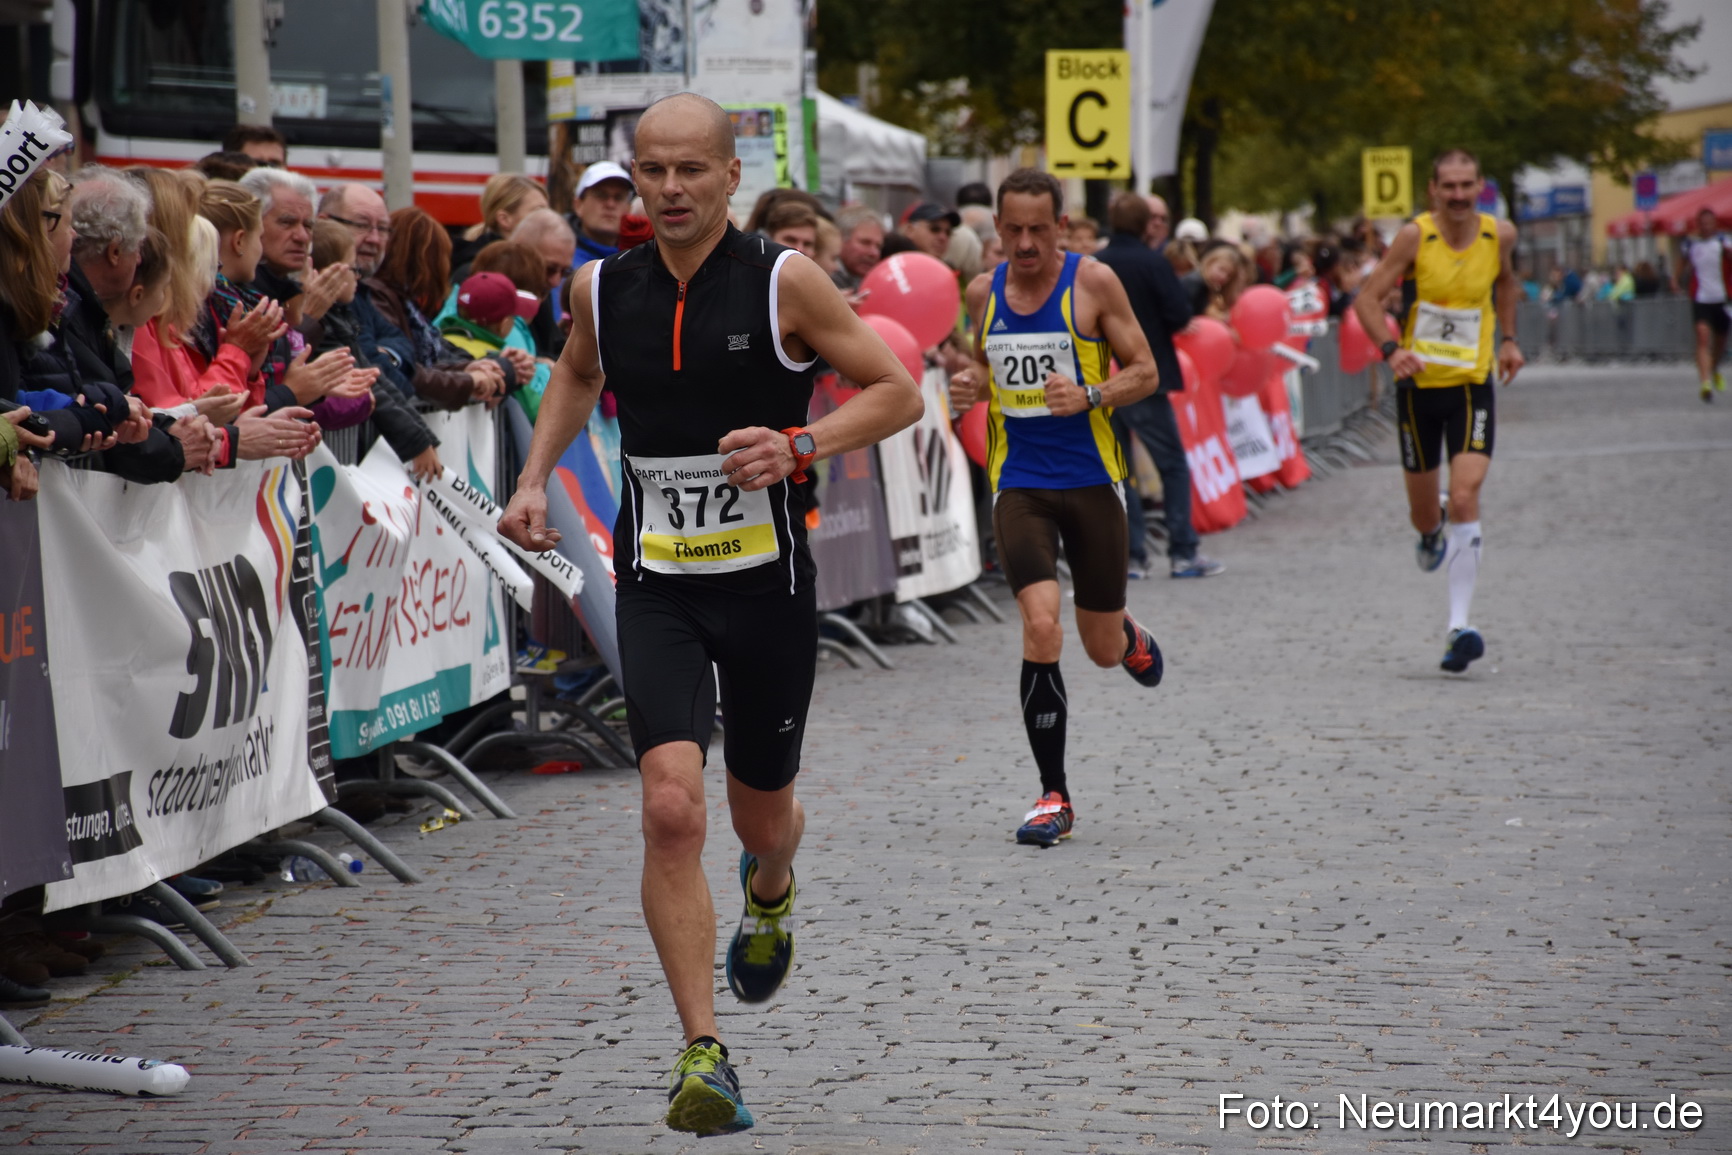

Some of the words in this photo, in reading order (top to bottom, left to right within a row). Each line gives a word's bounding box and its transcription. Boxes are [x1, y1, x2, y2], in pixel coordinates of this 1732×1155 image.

[478, 0, 584, 42] 6352
[1057, 57, 1121, 80] Block
[1069, 89, 1109, 150] C
[0, 130, 49, 200] port
[1377, 170, 1399, 203] D
[987, 344, 1014, 352] PARTL
[1016, 343, 1056, 352] Neumarkt
[1442, 321, 1455, 342] 2
[1003, 354, 1057, 386] 203
[635, 468, 672, 482] PARTL
[451, 476, 496, 516] BMW
[661, 482, 744, 530] 372
[647, 524, 653, 533] A
[673, 539, 742, 559] Thomas
